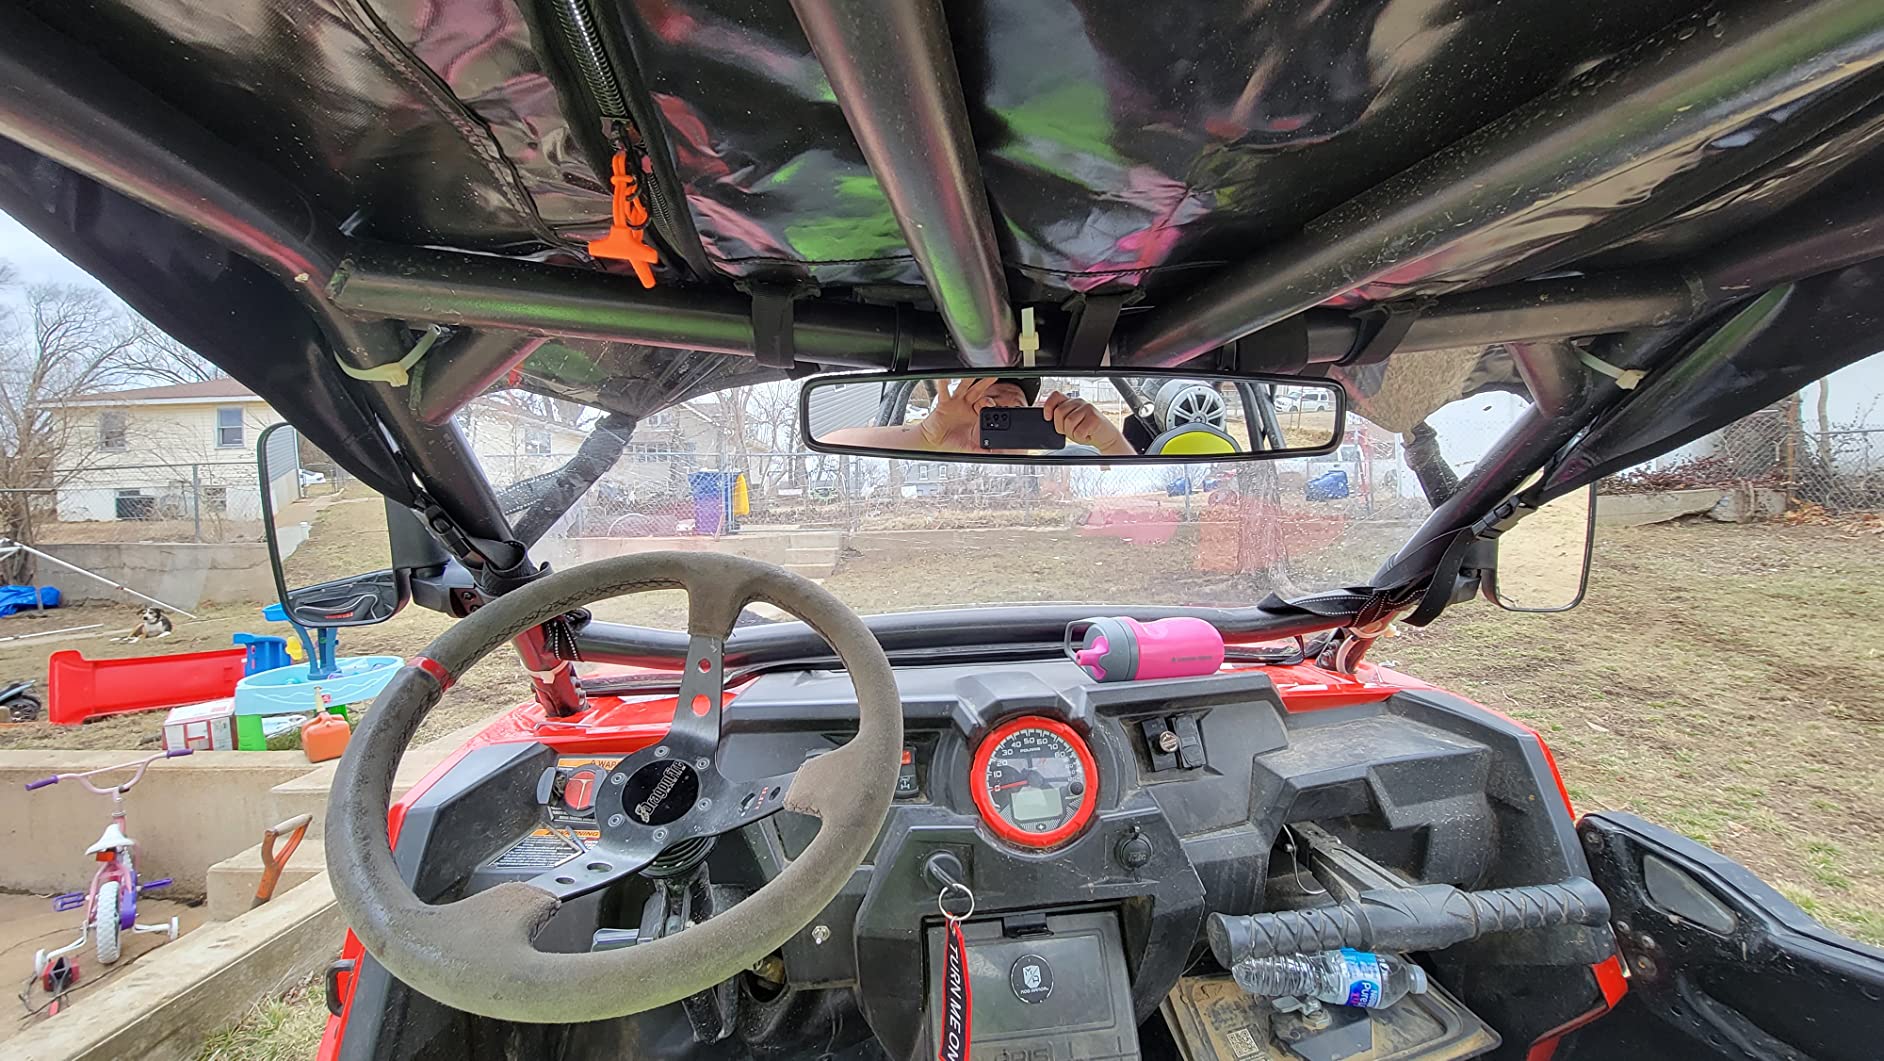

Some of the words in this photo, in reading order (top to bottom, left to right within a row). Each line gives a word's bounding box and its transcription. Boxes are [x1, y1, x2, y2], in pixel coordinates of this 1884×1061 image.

[1048, 743, 1058, 751] 70
[993, 770, 1002, 778] 10
[994, 784, 1001, 792] 0
[950, 944, 961, 999] TURN
[1359, 982, 1372, 1003] Pure
[950, 998, 961, 1034] ME
[947, 1032, 960, 1061] ON
